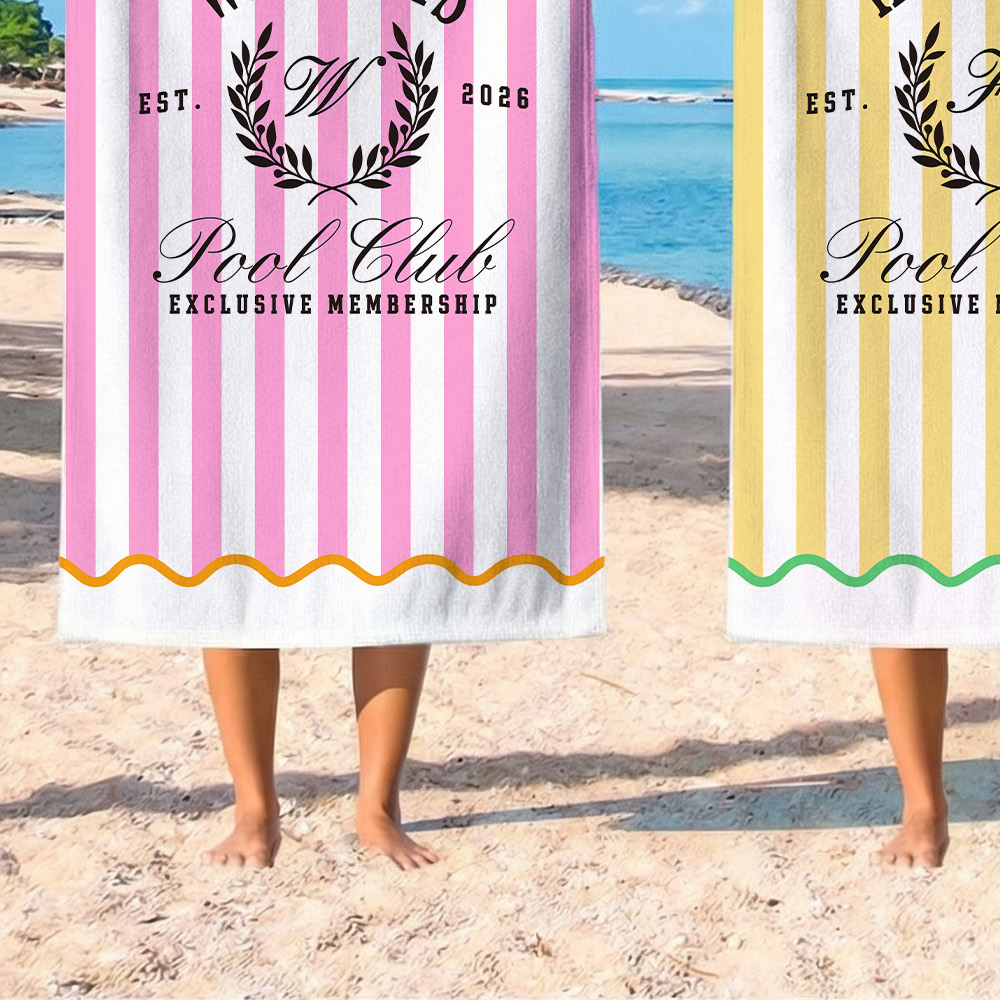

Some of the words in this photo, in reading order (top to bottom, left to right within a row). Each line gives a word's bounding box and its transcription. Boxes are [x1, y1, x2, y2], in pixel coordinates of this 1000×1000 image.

[283, 55, 387, 117] W
[462, 82, 529, 110] 2026
[139, 88, 201, 115] EST.
[806, 88, 868, 115] EST.
[153, 216, 341, 284] Pool
[350, 216, 516, 284] Club
[169, 294, 313, 315] EXCLUSIVE
[327, 294, 498, 315] MEMBERSHIP
[836, 294, 980, 315] EXCLUSIVE
